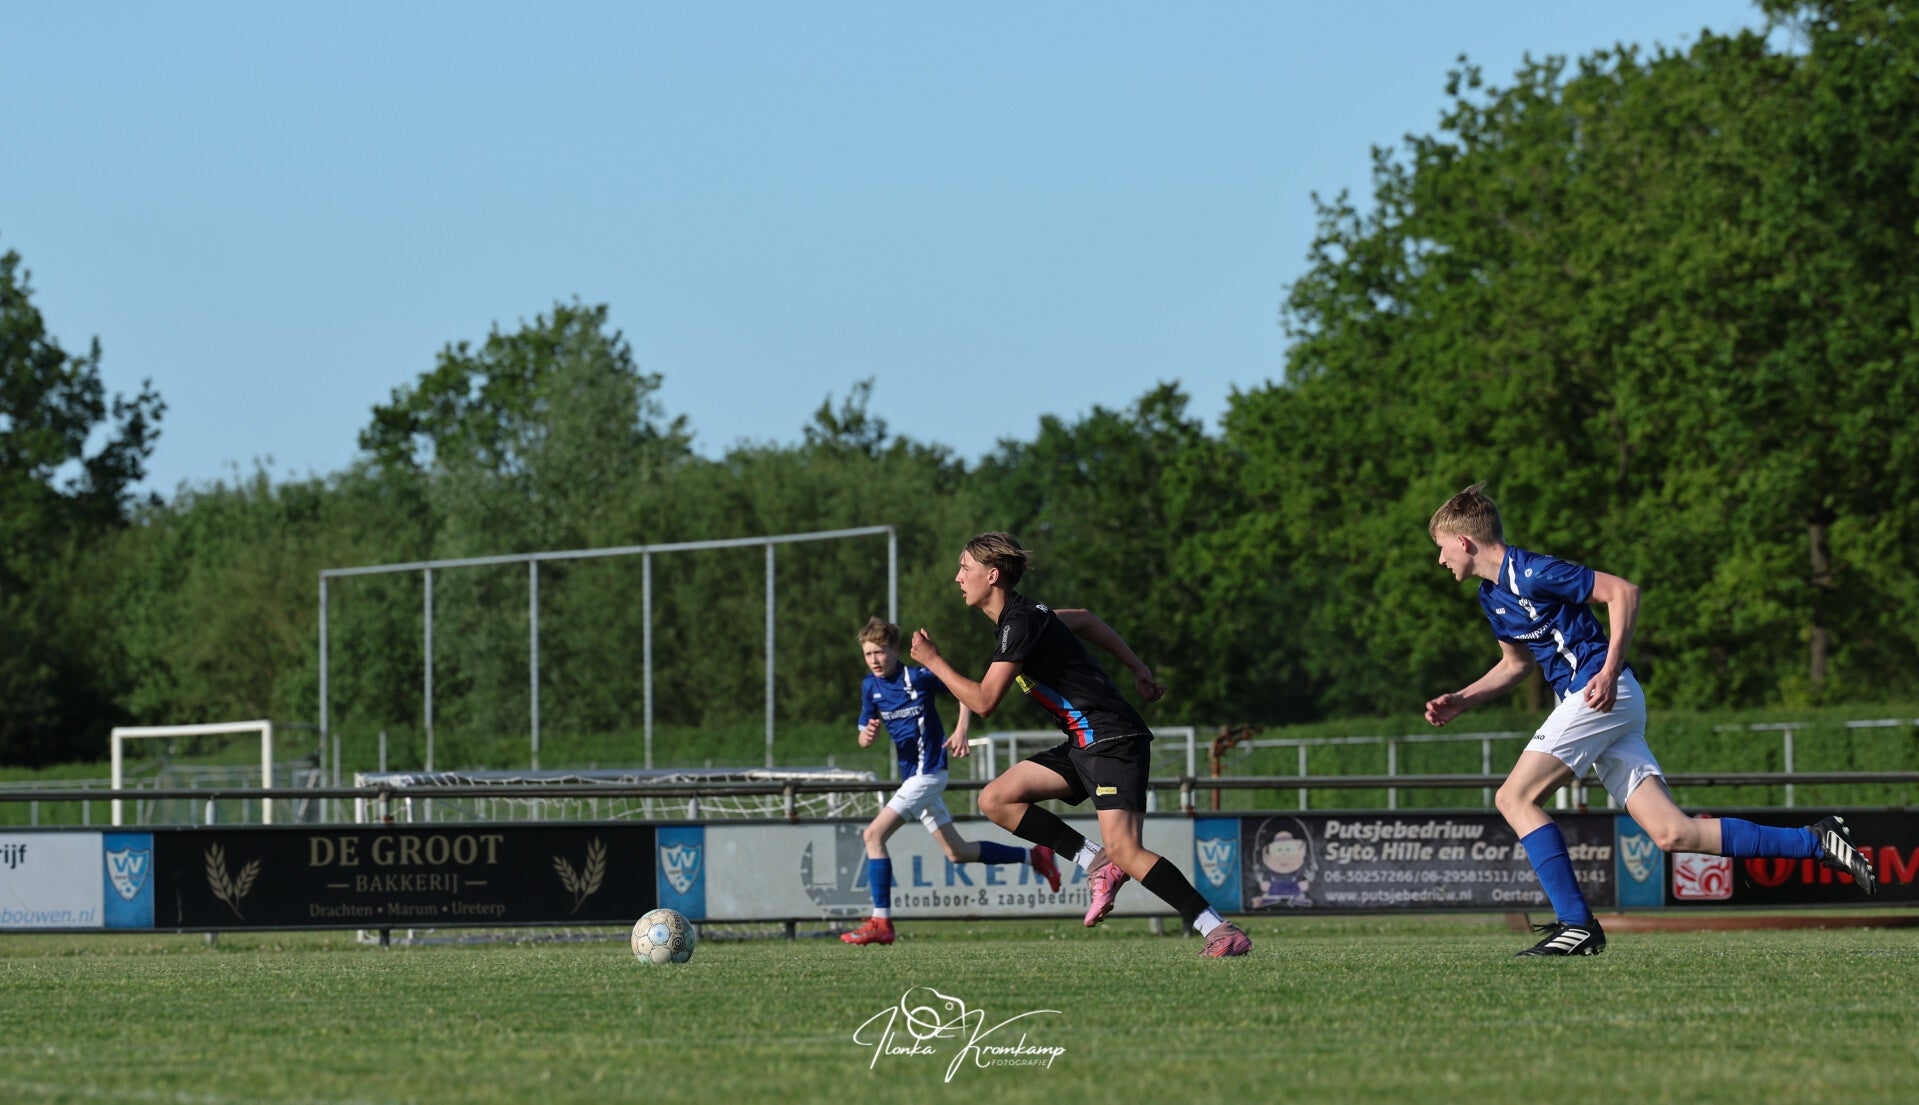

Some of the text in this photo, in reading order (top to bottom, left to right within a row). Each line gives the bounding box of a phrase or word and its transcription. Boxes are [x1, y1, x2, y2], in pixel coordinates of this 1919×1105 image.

[1324, 820, 1484, 843] Putsjebedriuw
[0, 844, 27, 869] ijf
[309, 834, 505, 867] DE GROOT
[1381, 842, 1432, 861] Hille
[1438, 848, 1466, 861] en
[1471, 841, 1511, 861] Cor
[356, 873, 458, 894] BAKKERIJ
[894, 889, 976, 908] etonboor-
[309, 902, 506, 918] Drachten Marum Ureterp
